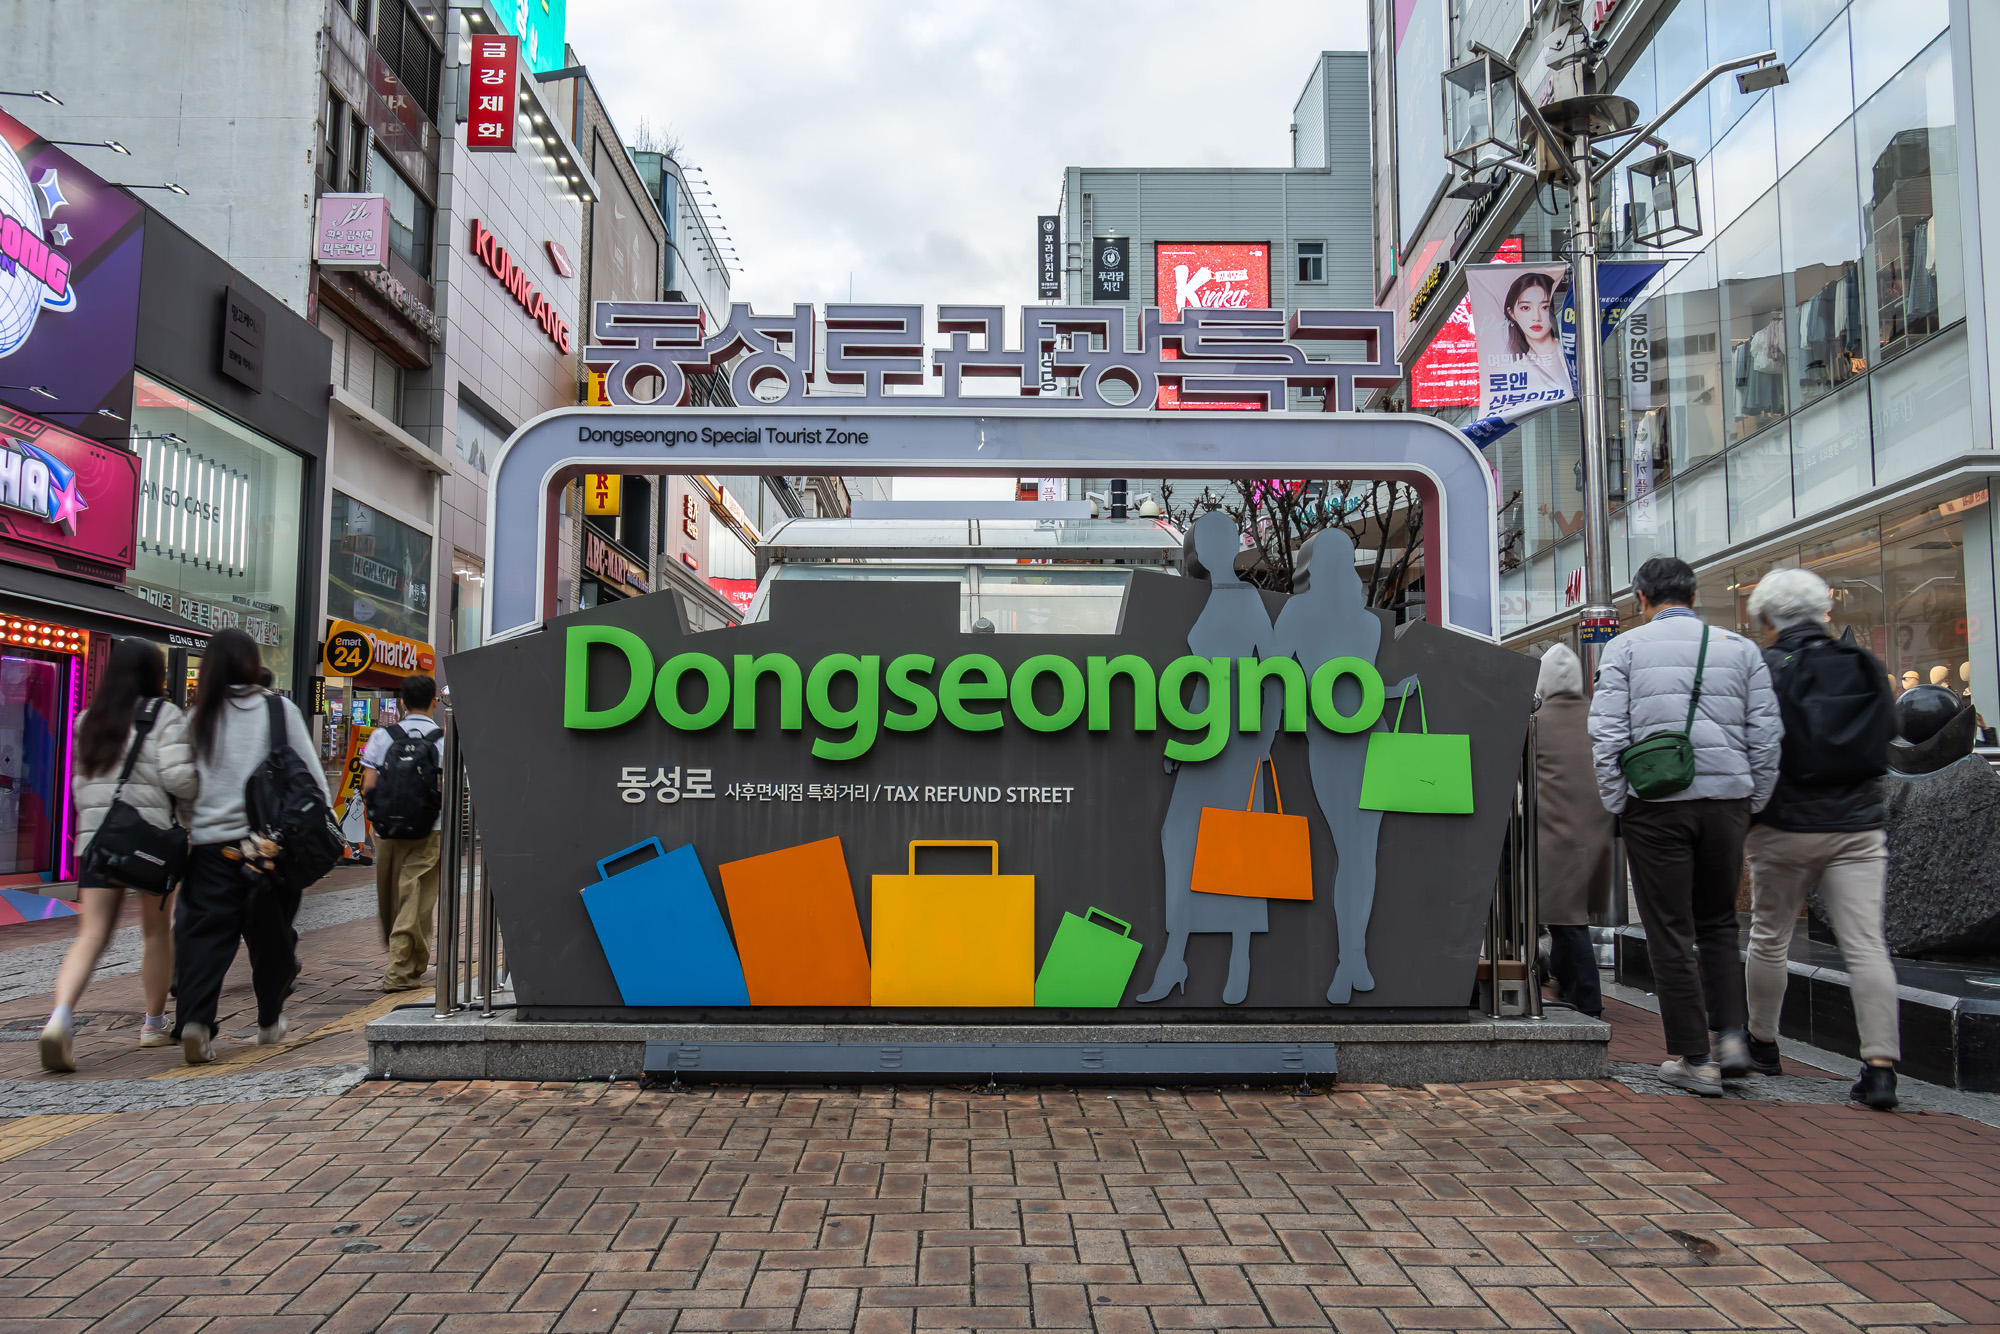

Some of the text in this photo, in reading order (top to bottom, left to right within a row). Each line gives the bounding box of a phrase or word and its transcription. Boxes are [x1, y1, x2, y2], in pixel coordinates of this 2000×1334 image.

[478, 42, 507, 138] 금강제화
[1044, 234, 1055, 282] 푸라닭치킨
[472, 219, 569, 355] KUMKANG
[1098, 271, 1125, 282] 푸라닭
[1103, 281, 1121, 292] 치킨
[583, 301, 1403, 412] 동성로관광특구
[1489, 371, 1528, 393] 로앤
[578, 426, 869, 447] Dongseongno Special Tourist Zone
[184, 496, 220, 524] CASE
[585, 531, 628, 586] ABC-MART
[232, 595, 251, 607] MOBILE
[169, 634, 193, 646] BONG
[335, 637, 362, 647] emart
[334, 647, 362, 668] 24
[563, 625, 1385, 762] Dongseongno
[617, 766, 716, 804] 동성로
[724, 783, 804, 802] 사후면세점
[807, 783, 869, 802] 특화거리
[924, 786, 1002, 803] REFUND
[1006, 786, 1075, 803] STREET
